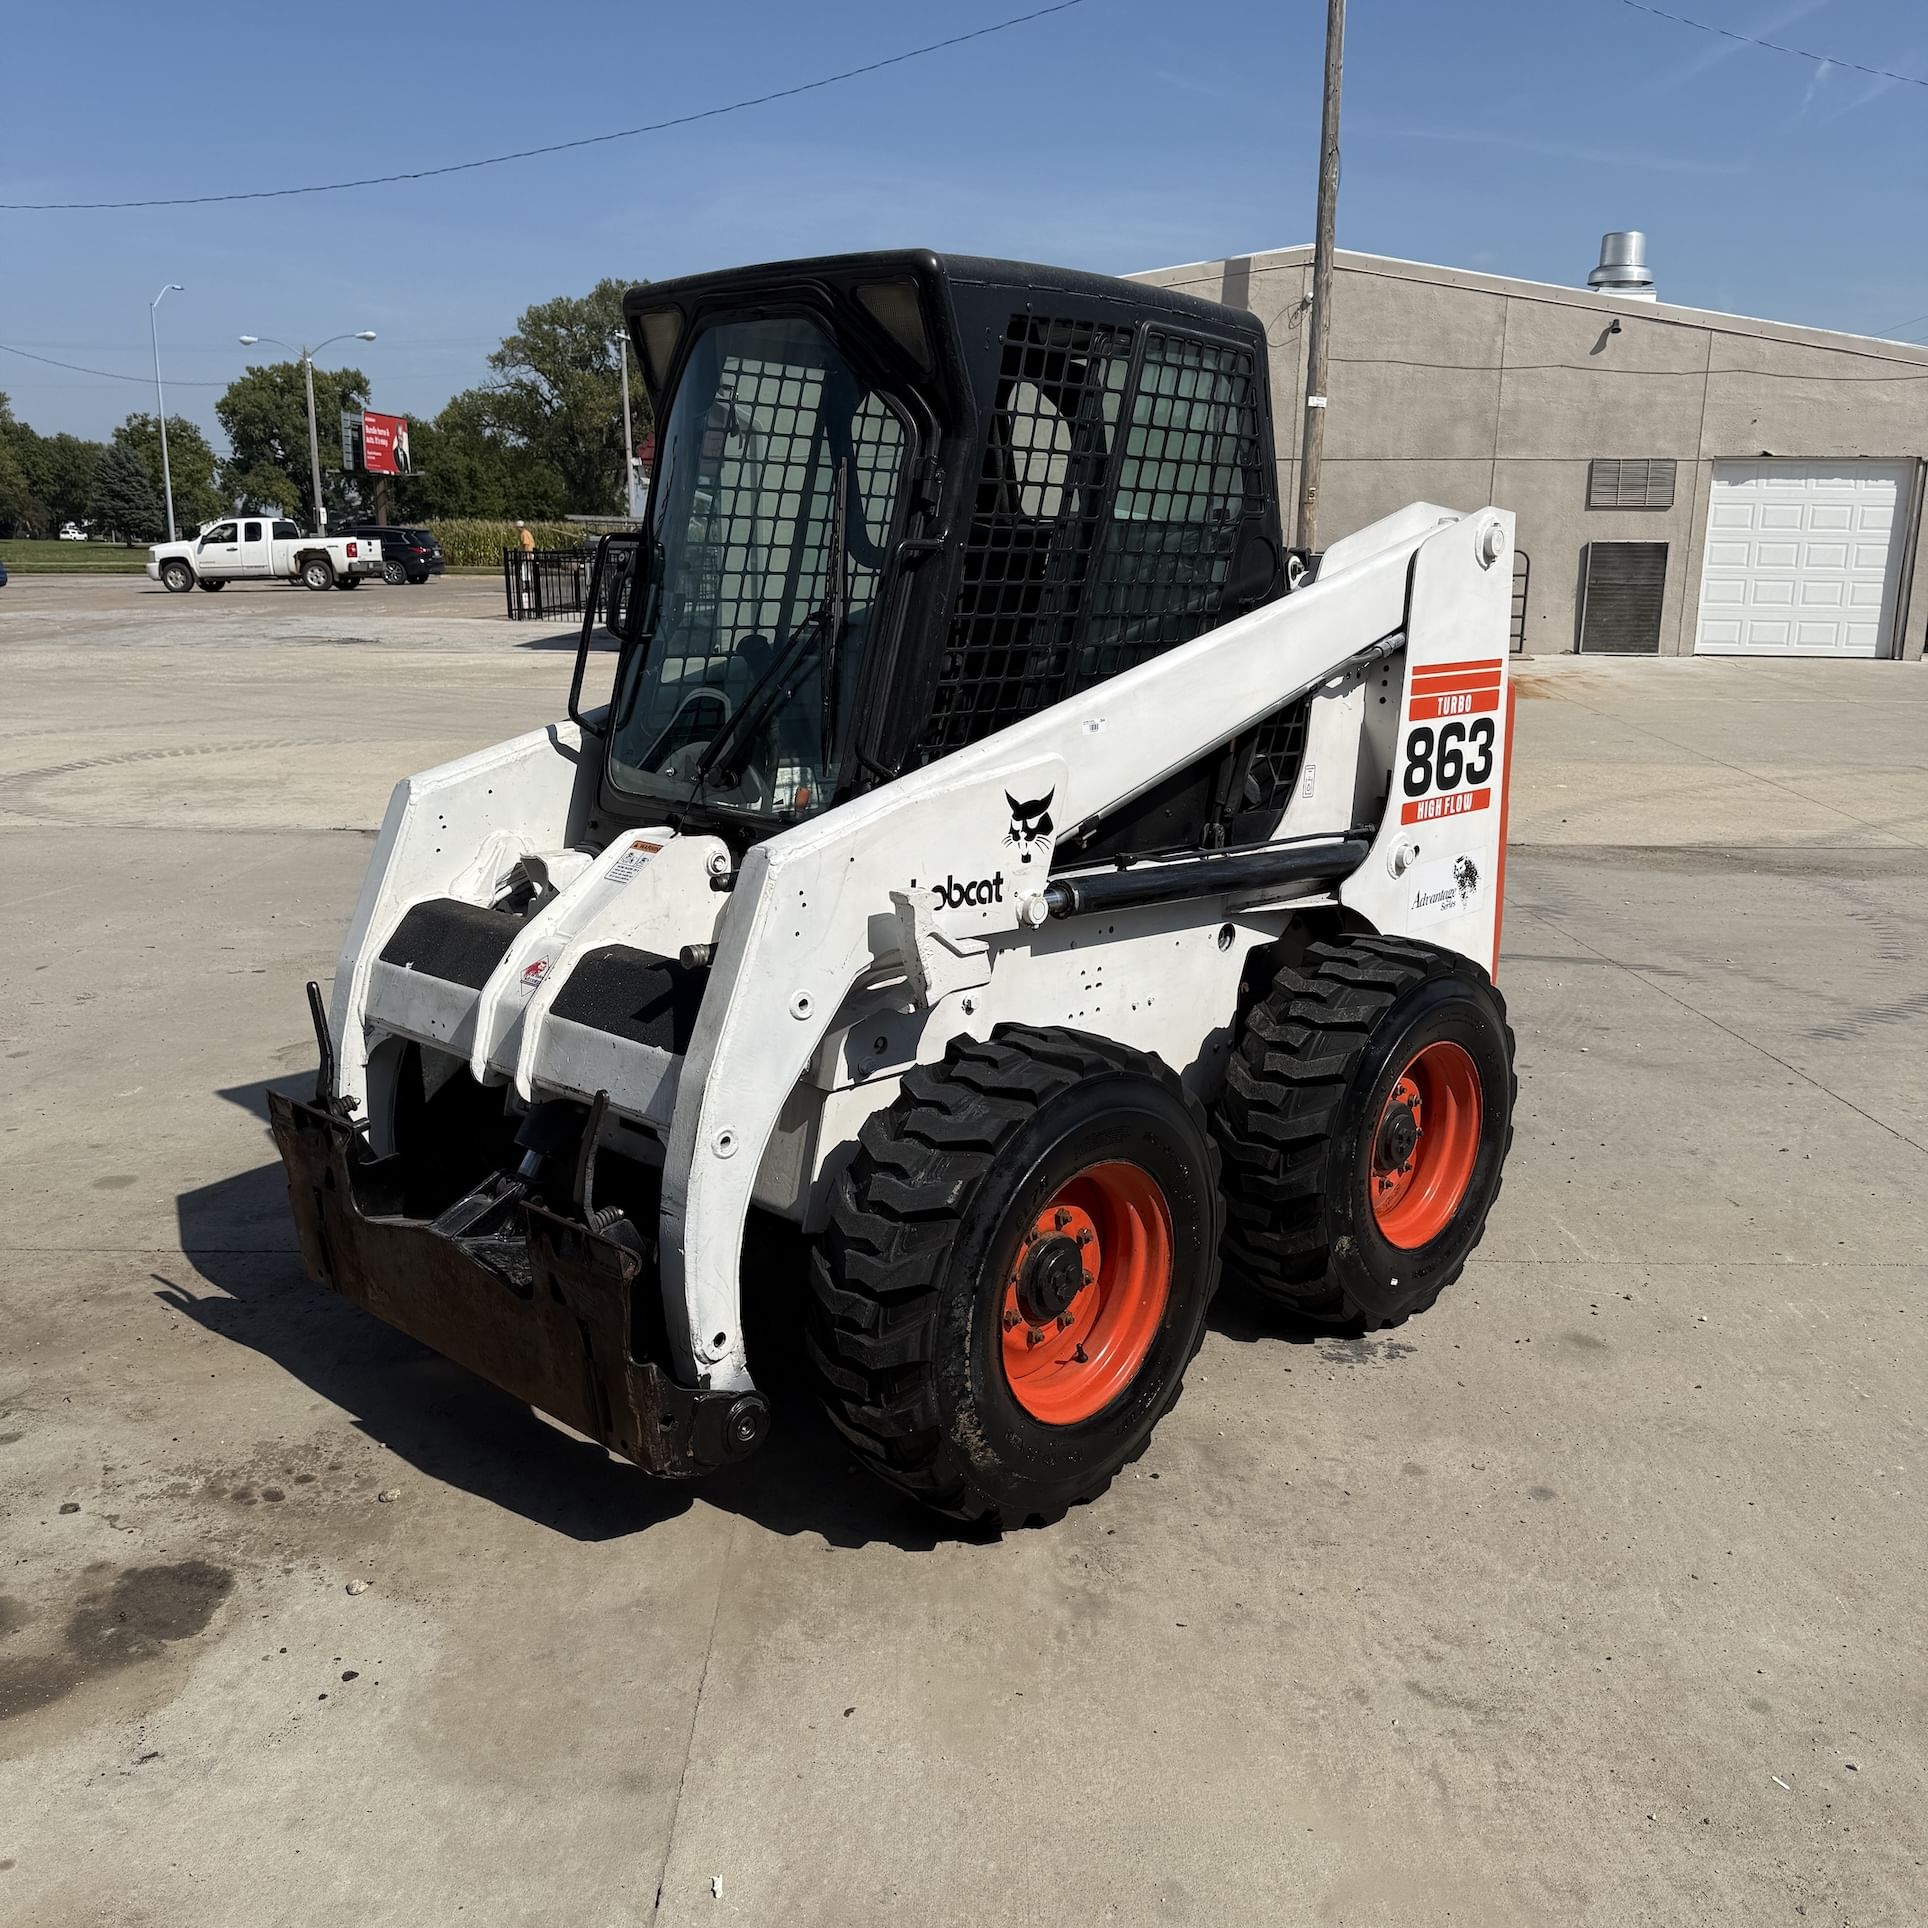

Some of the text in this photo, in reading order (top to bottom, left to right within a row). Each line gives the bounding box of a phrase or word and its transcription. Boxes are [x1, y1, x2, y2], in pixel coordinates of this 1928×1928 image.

[1437, 694, 1472, 716] TURBO
[1403, 717, 1495, 797] 863
[1416, 792, 1473, 820] HIGH FLOW
[911, 871, 1004, 911] obcat
[1410, 888, 1457, 910] Advantage
[1440, 901, 1457, 912] Series
